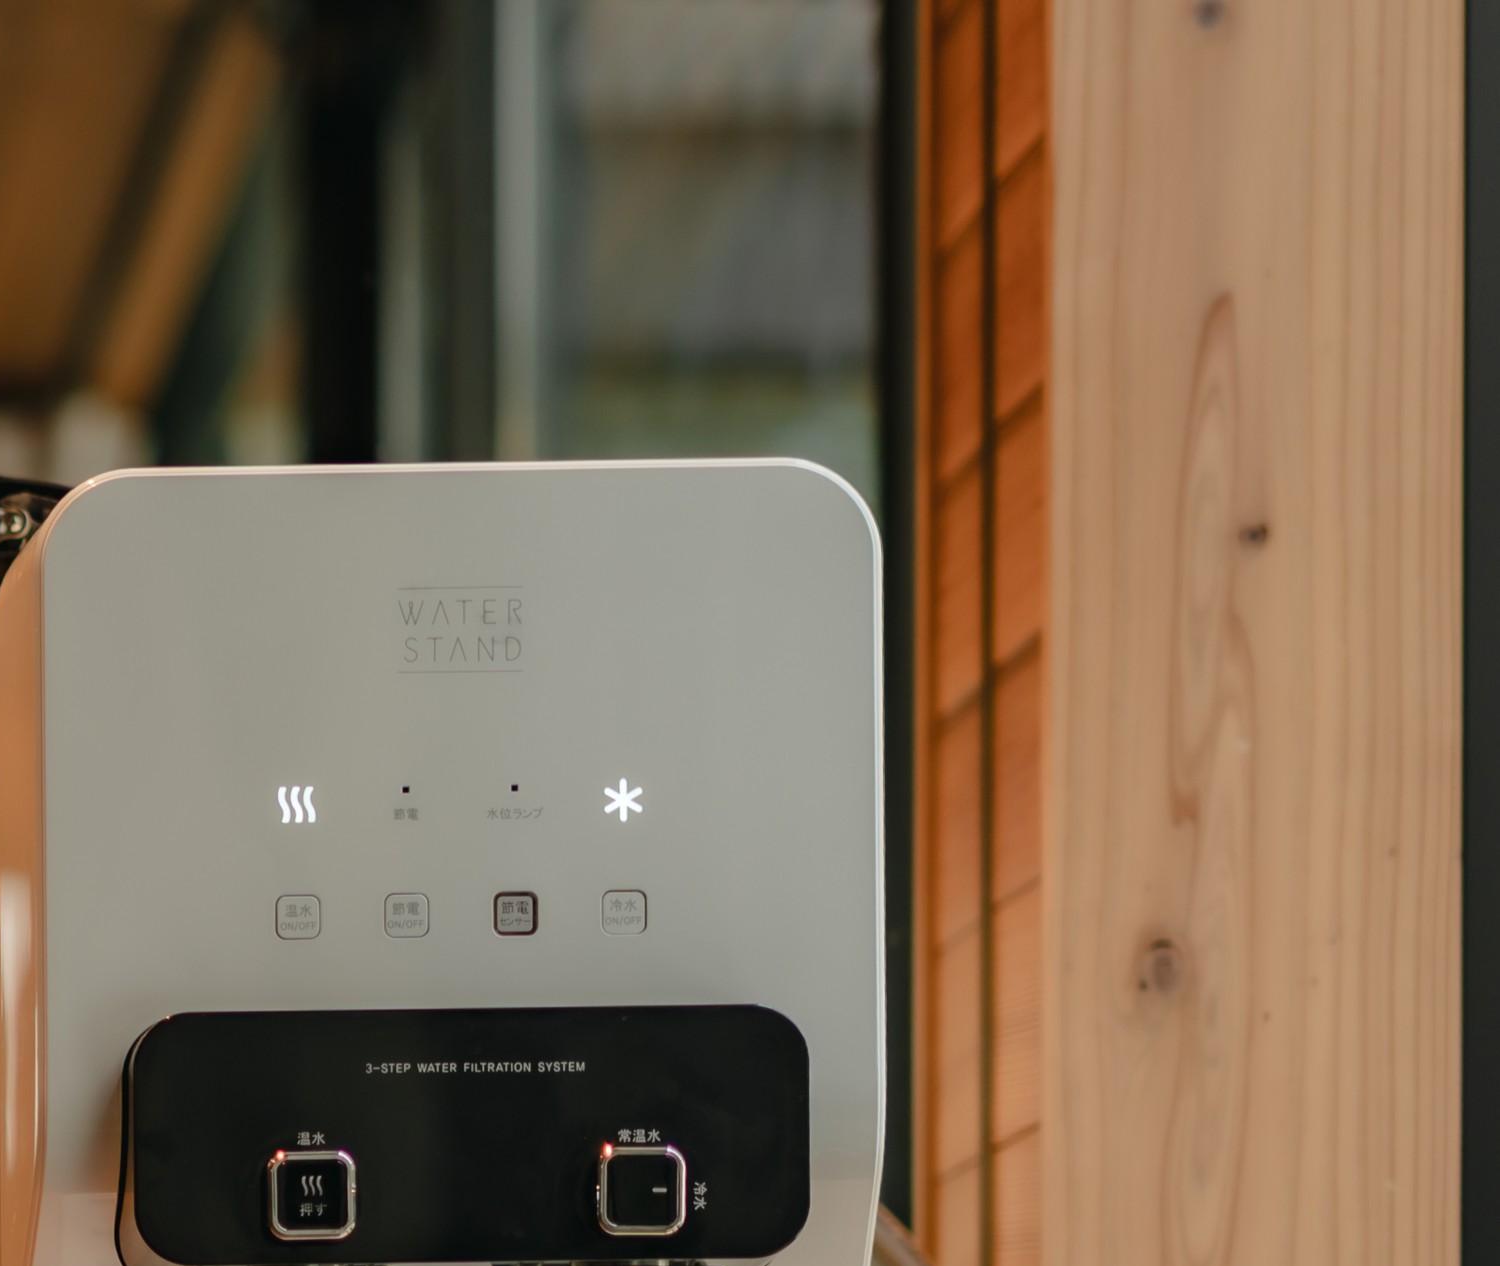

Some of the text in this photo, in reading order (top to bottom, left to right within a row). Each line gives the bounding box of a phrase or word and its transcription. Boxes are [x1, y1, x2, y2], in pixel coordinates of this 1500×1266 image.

[398, 598, 523, 626] WATER
[403, 635, 523, 663] STAND
[280, 920, 318, 932] ON/OFF
[387, 919, 425, 930] ON/OFF
[604, 915, 643, 926] ON/OFF
[365, 1061, 586, 1074] 3-STEP WATER FILTRATION SYSTEM
[297, 1131, 326, 1146] 温水
[617, 1128, 662, 1144] 常温水
[692, 1181, 708, 1211] 冷水
[299, 1202, 328, 1217] 押す
